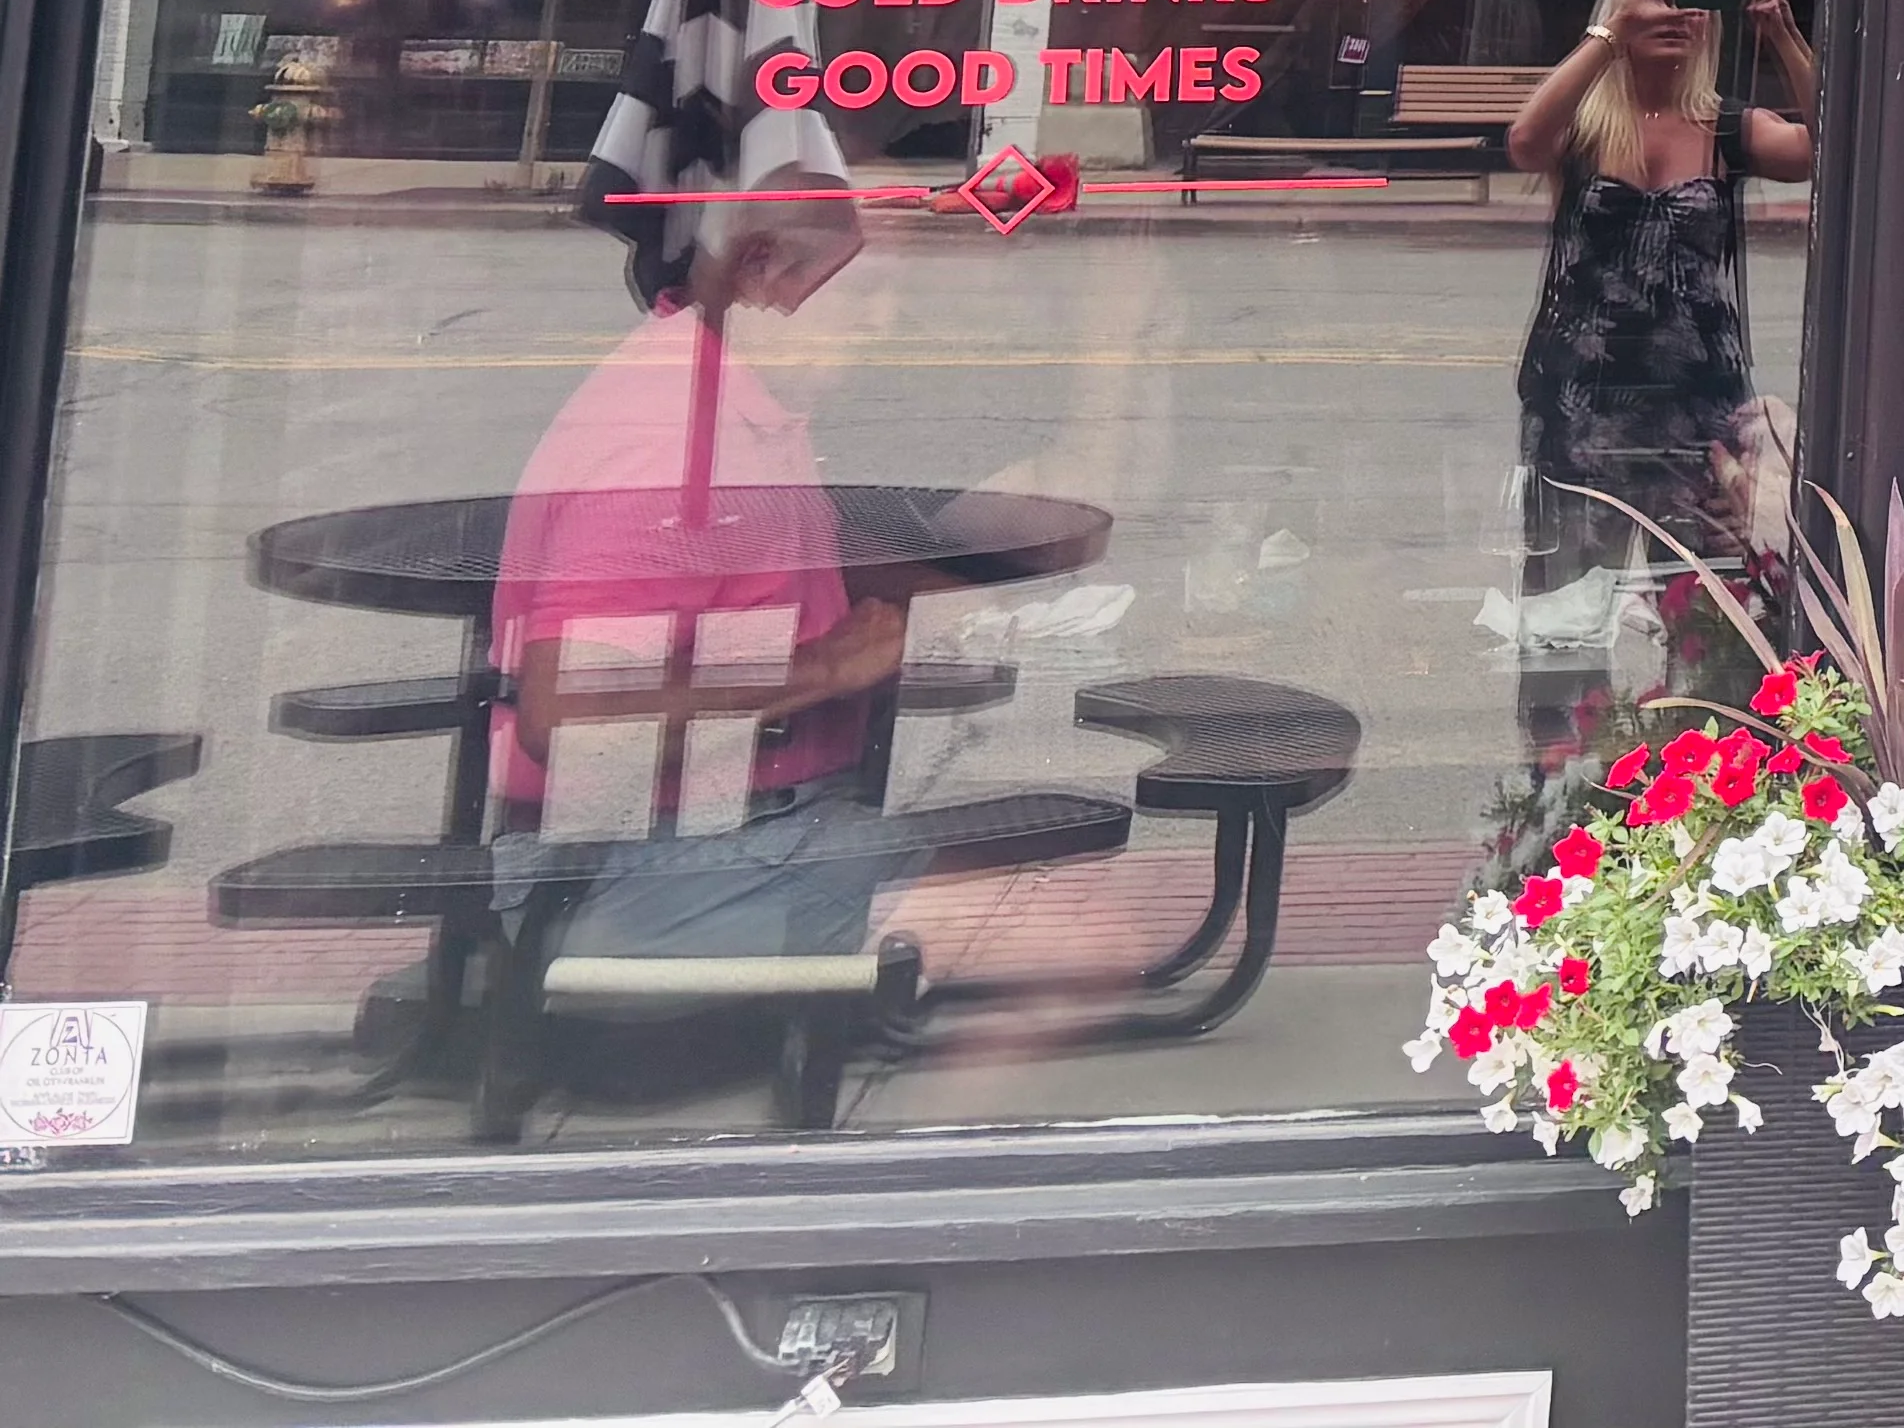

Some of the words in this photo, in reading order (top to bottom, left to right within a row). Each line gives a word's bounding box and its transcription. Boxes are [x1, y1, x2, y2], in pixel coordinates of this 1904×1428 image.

[755, 50, 1015, 111] GOOD
[1038, 47, 1263, 105] TIMES
[31, 1045, 108, 1066] ZONTA
